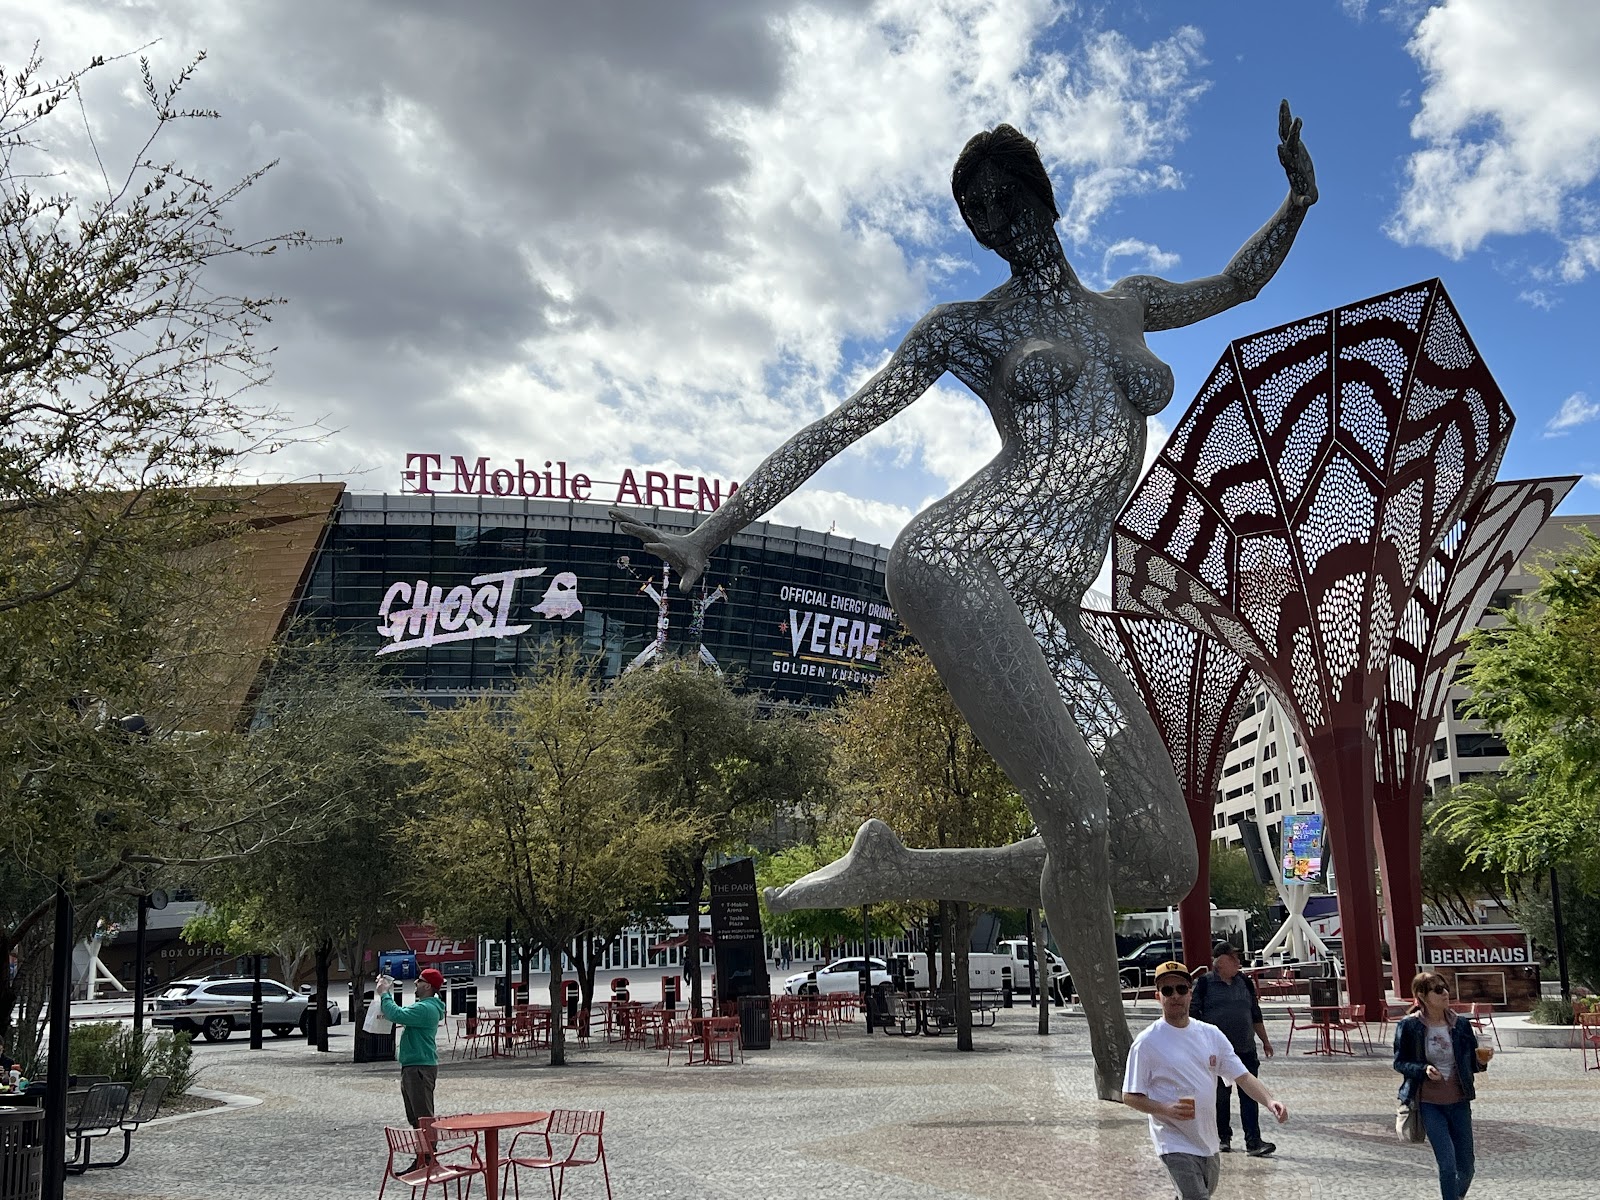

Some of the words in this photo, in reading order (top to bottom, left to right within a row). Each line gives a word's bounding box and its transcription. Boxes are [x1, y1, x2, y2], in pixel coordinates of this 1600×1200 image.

[375, 566, 548, 656] GHOST
[780, 585, 828, 608] OFFICIAL
[830, 594, 868, 615] ENERGY
[868, 602, 893, 620] DRINK
[788, 608, 882, 663] VEGAS
[772, 660, 826, 678] GOLDEN
[714, 884, 729, 892] THE
[161, 949, 183, 958] BOX
[424, 939, 467, 956] UFC
[1430, 947, 1526, 964] BEERHAUS
